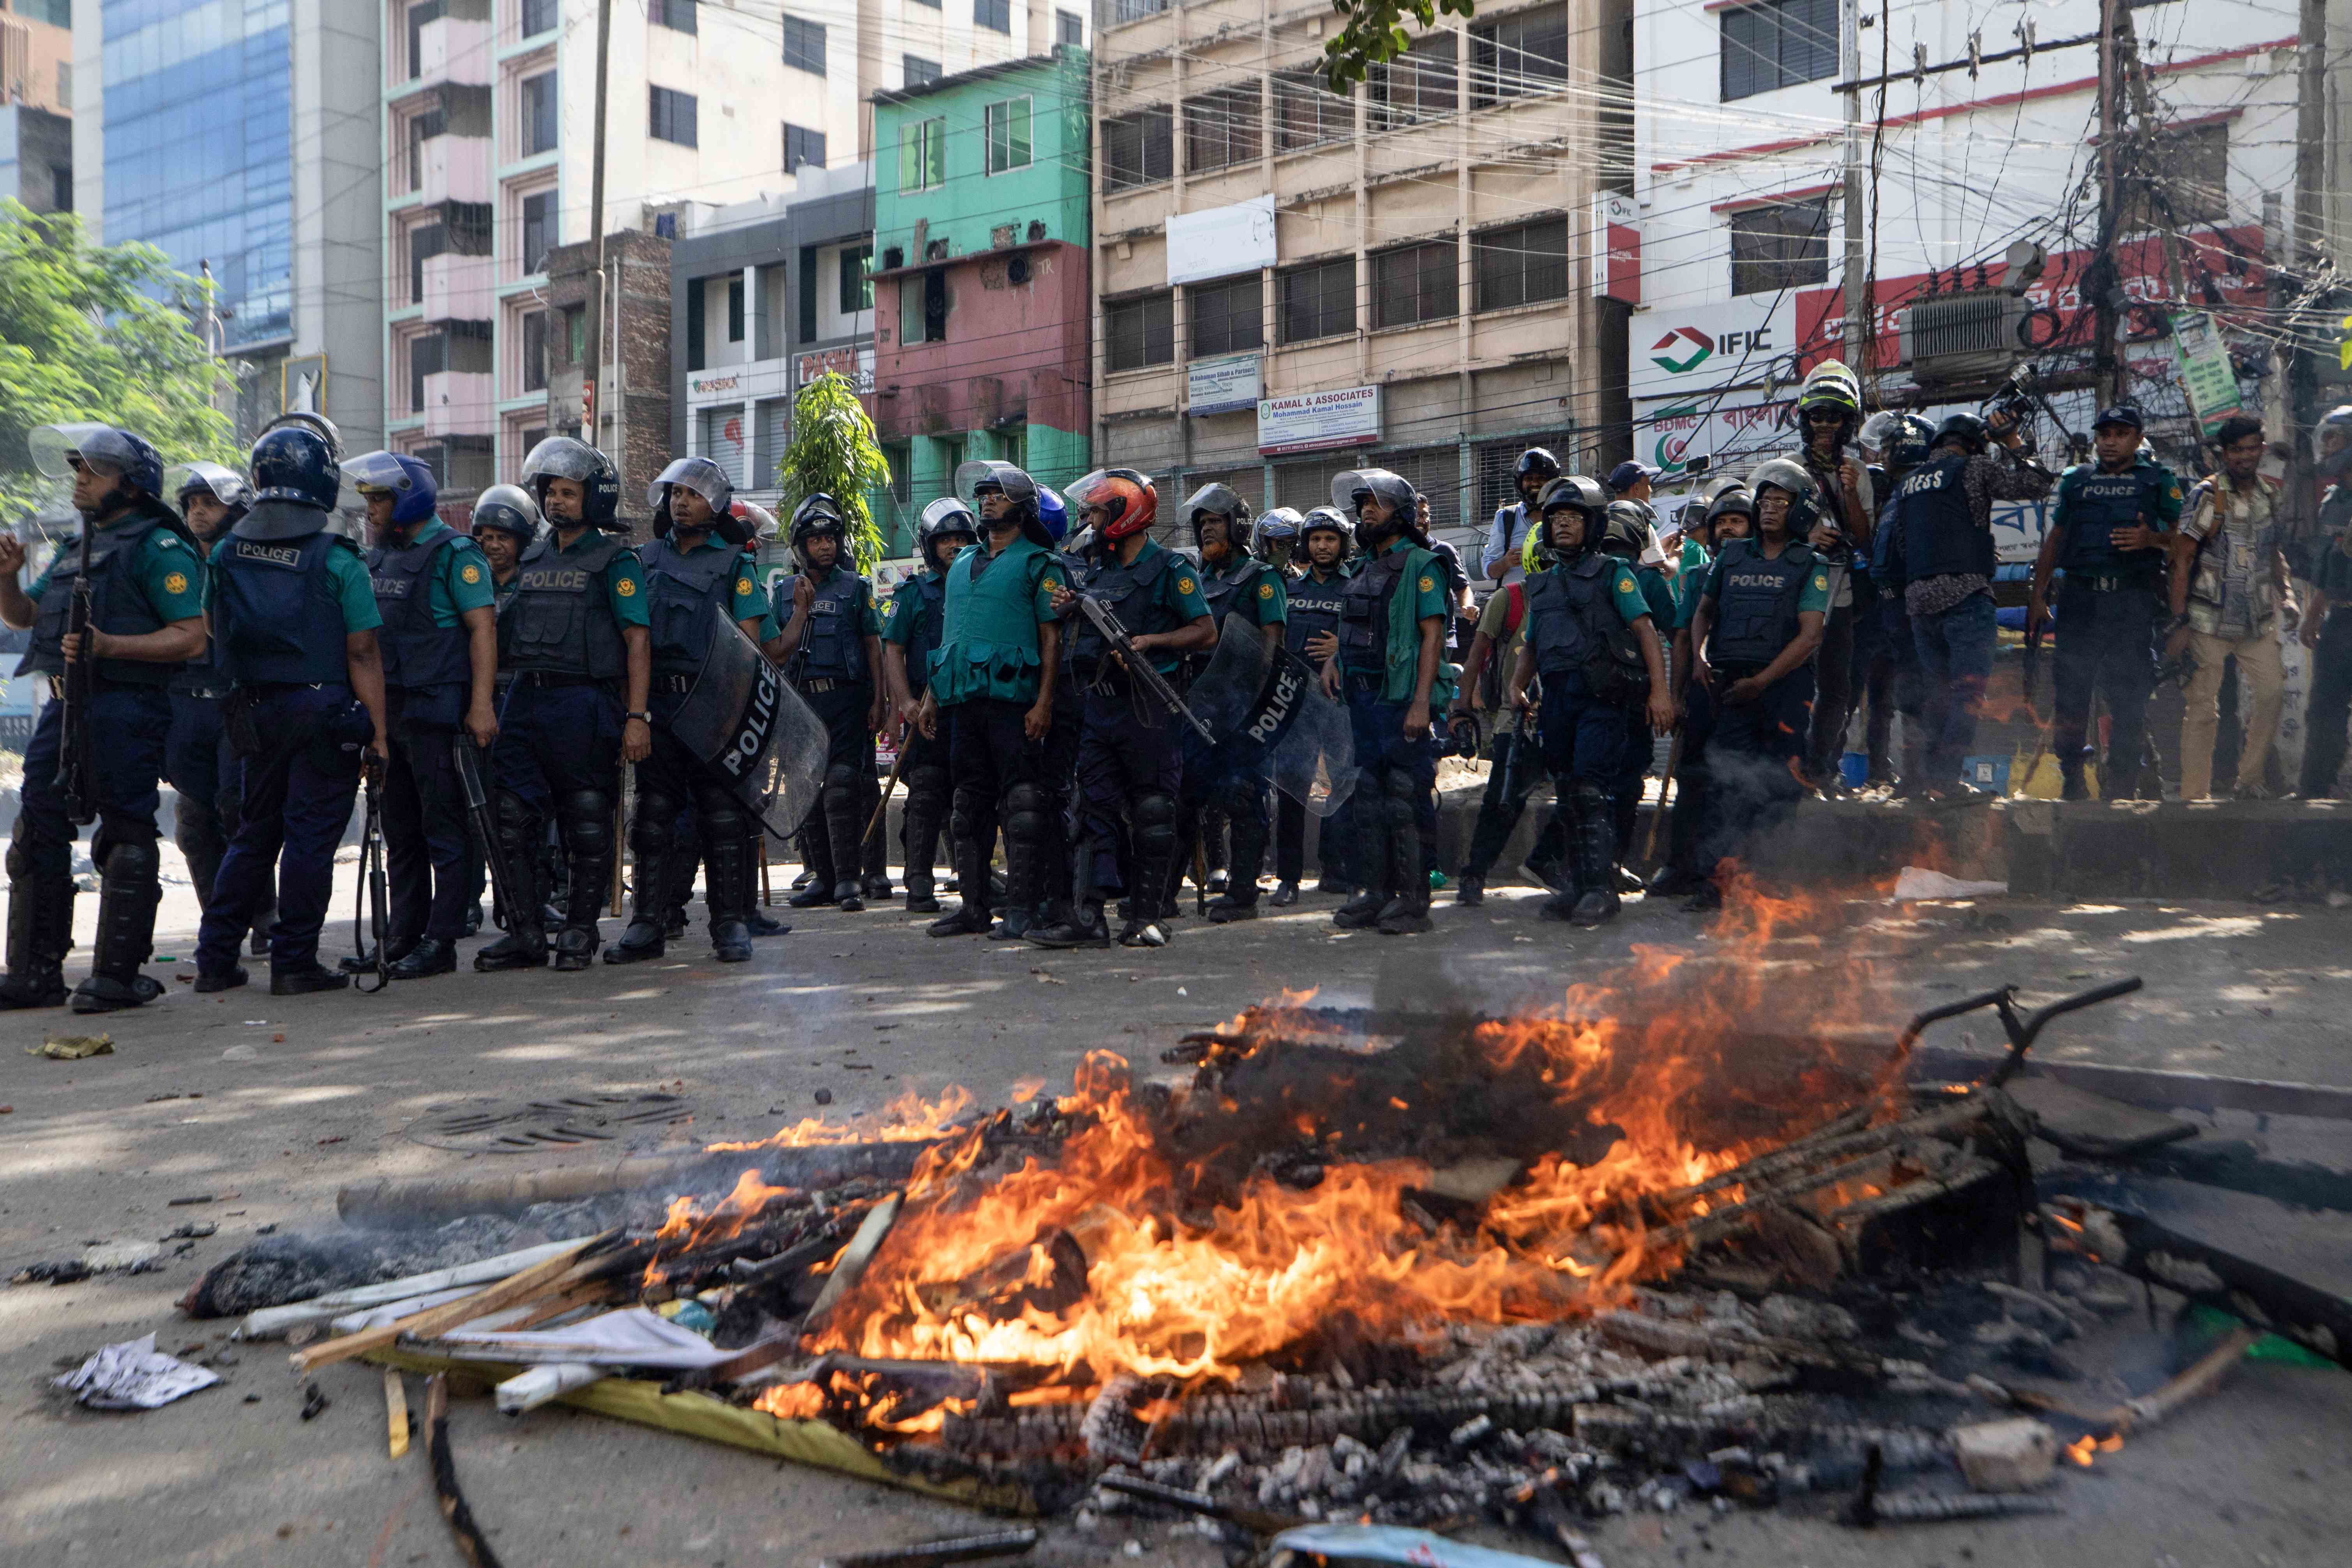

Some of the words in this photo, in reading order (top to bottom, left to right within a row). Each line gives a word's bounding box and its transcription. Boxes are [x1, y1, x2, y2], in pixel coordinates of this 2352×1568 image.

[1622, 206, 1632, 217] IFIC
[1720, 328, 1771, 355] IFIC
[802, 349, 859, 382] PASHA
[1234, 367, 1255, 375] Partners
[1271, 399, 1303, 410] KAMAL
[1306, 397, 1312, 406] &
[1315, 388, 1374, 404] ASSOCIATES
[1273, 408, 1310, 418] Mohammad
[1312, 404, 1333, 413] Kamal
[1335, 401, 1363, 410] Hossain
[1654, 415, 1697, 432] BDMC
[599, 484, 618, 493] POLICE
[1902, 470, 1944, 498] PRESS
[2082, 485, 2136, 498] POLICE
[242, 544, 292, 561] POLICE
[521, 571, 586, 588] POLICE
[1729, 574, 1784, 588] POLICE
[1286, 598, 1342, 611] POLICE
[1248, 671, 1298, 743] POLICE
[722, 660, 776, 775] POLICE
